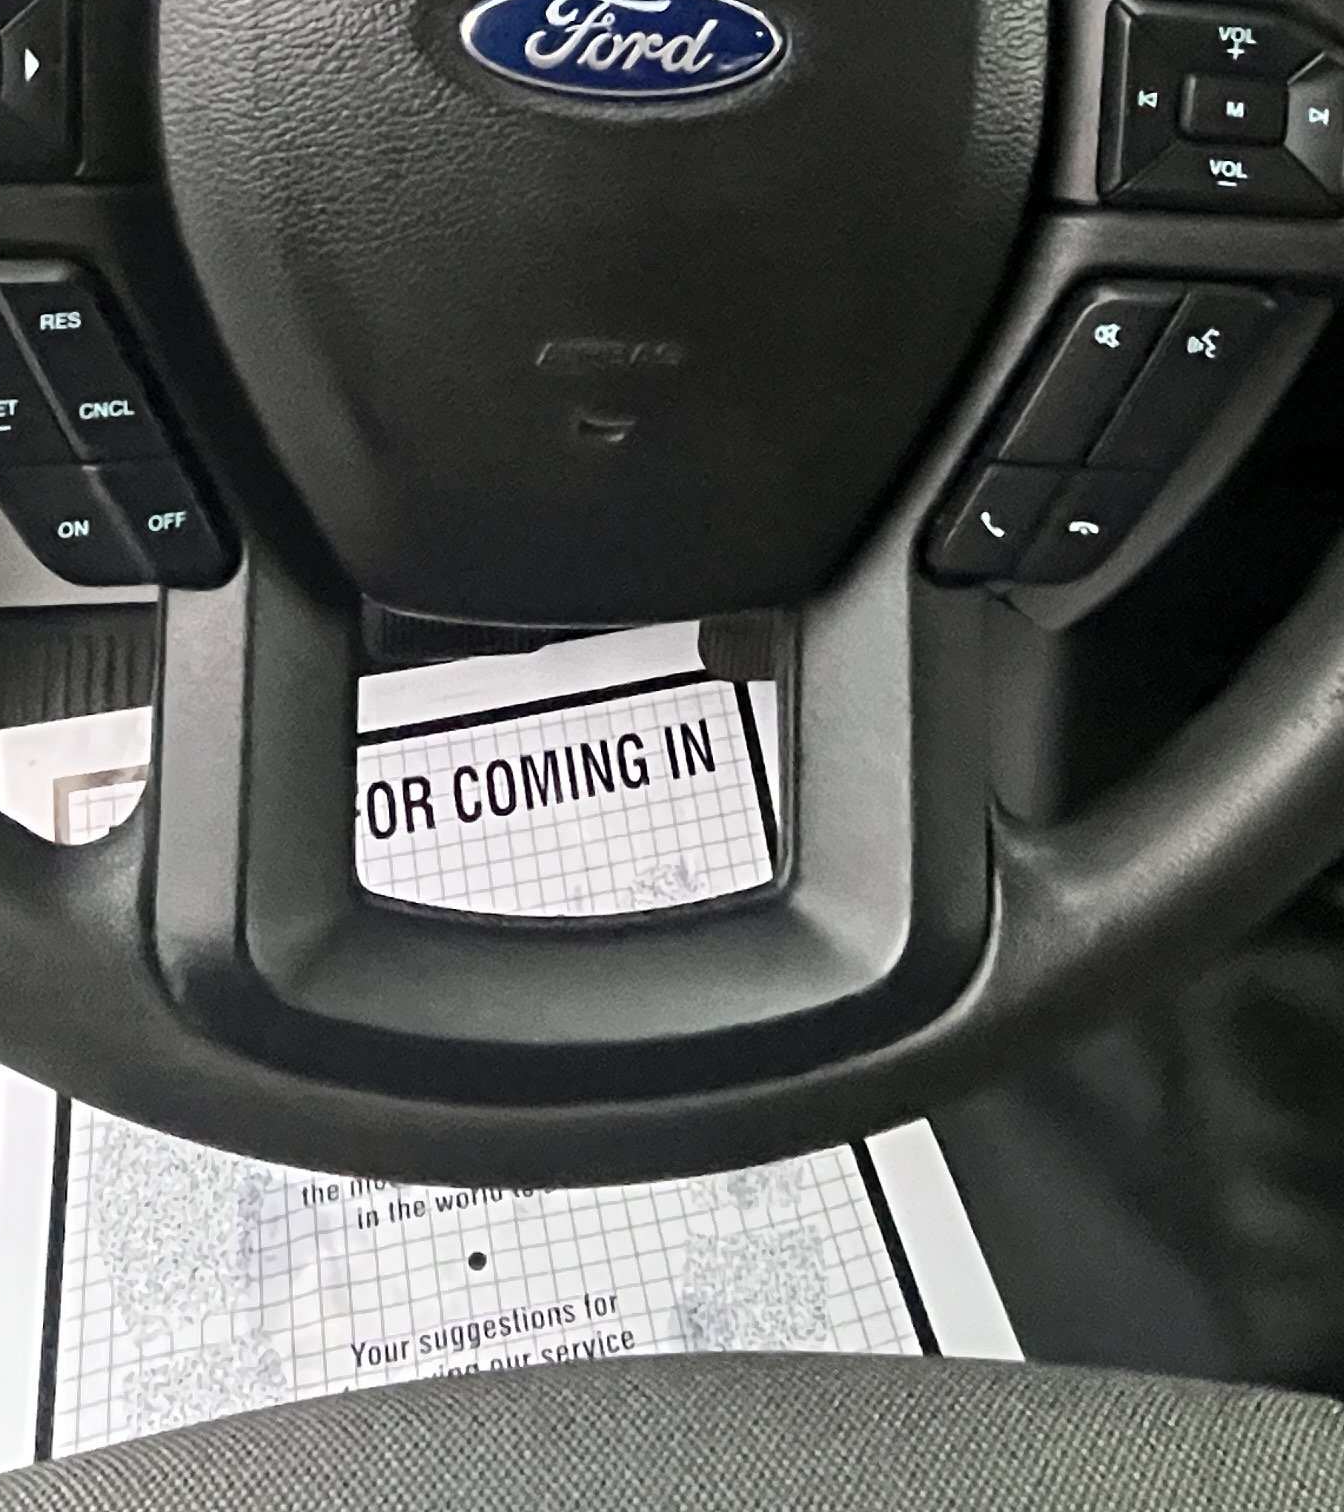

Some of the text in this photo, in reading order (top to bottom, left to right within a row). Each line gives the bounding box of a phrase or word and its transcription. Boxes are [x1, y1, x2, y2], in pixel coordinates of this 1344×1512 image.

[1218, 26, 1257, 44] VOL
[1226, 101, 1244, 118] M
[1209, 159, 1248, 179] VOL
[40, 312, 82, 330] RES
[79, 400, 135, 420] CNCL
[58, 520, 90, 538] ON
[148, 510, 187, 532] OFF
[454, 733, 649, 823] COMING
[664, 719, 716, 779] IN
[302, 1177, 340, 1206] the
[357, 1207, 380, 1229] in
[389, 1197, 426, 1223] the
[350, 1293, 617, 1368] Your suggestions for
[541, 1330, 636, 1365] service
